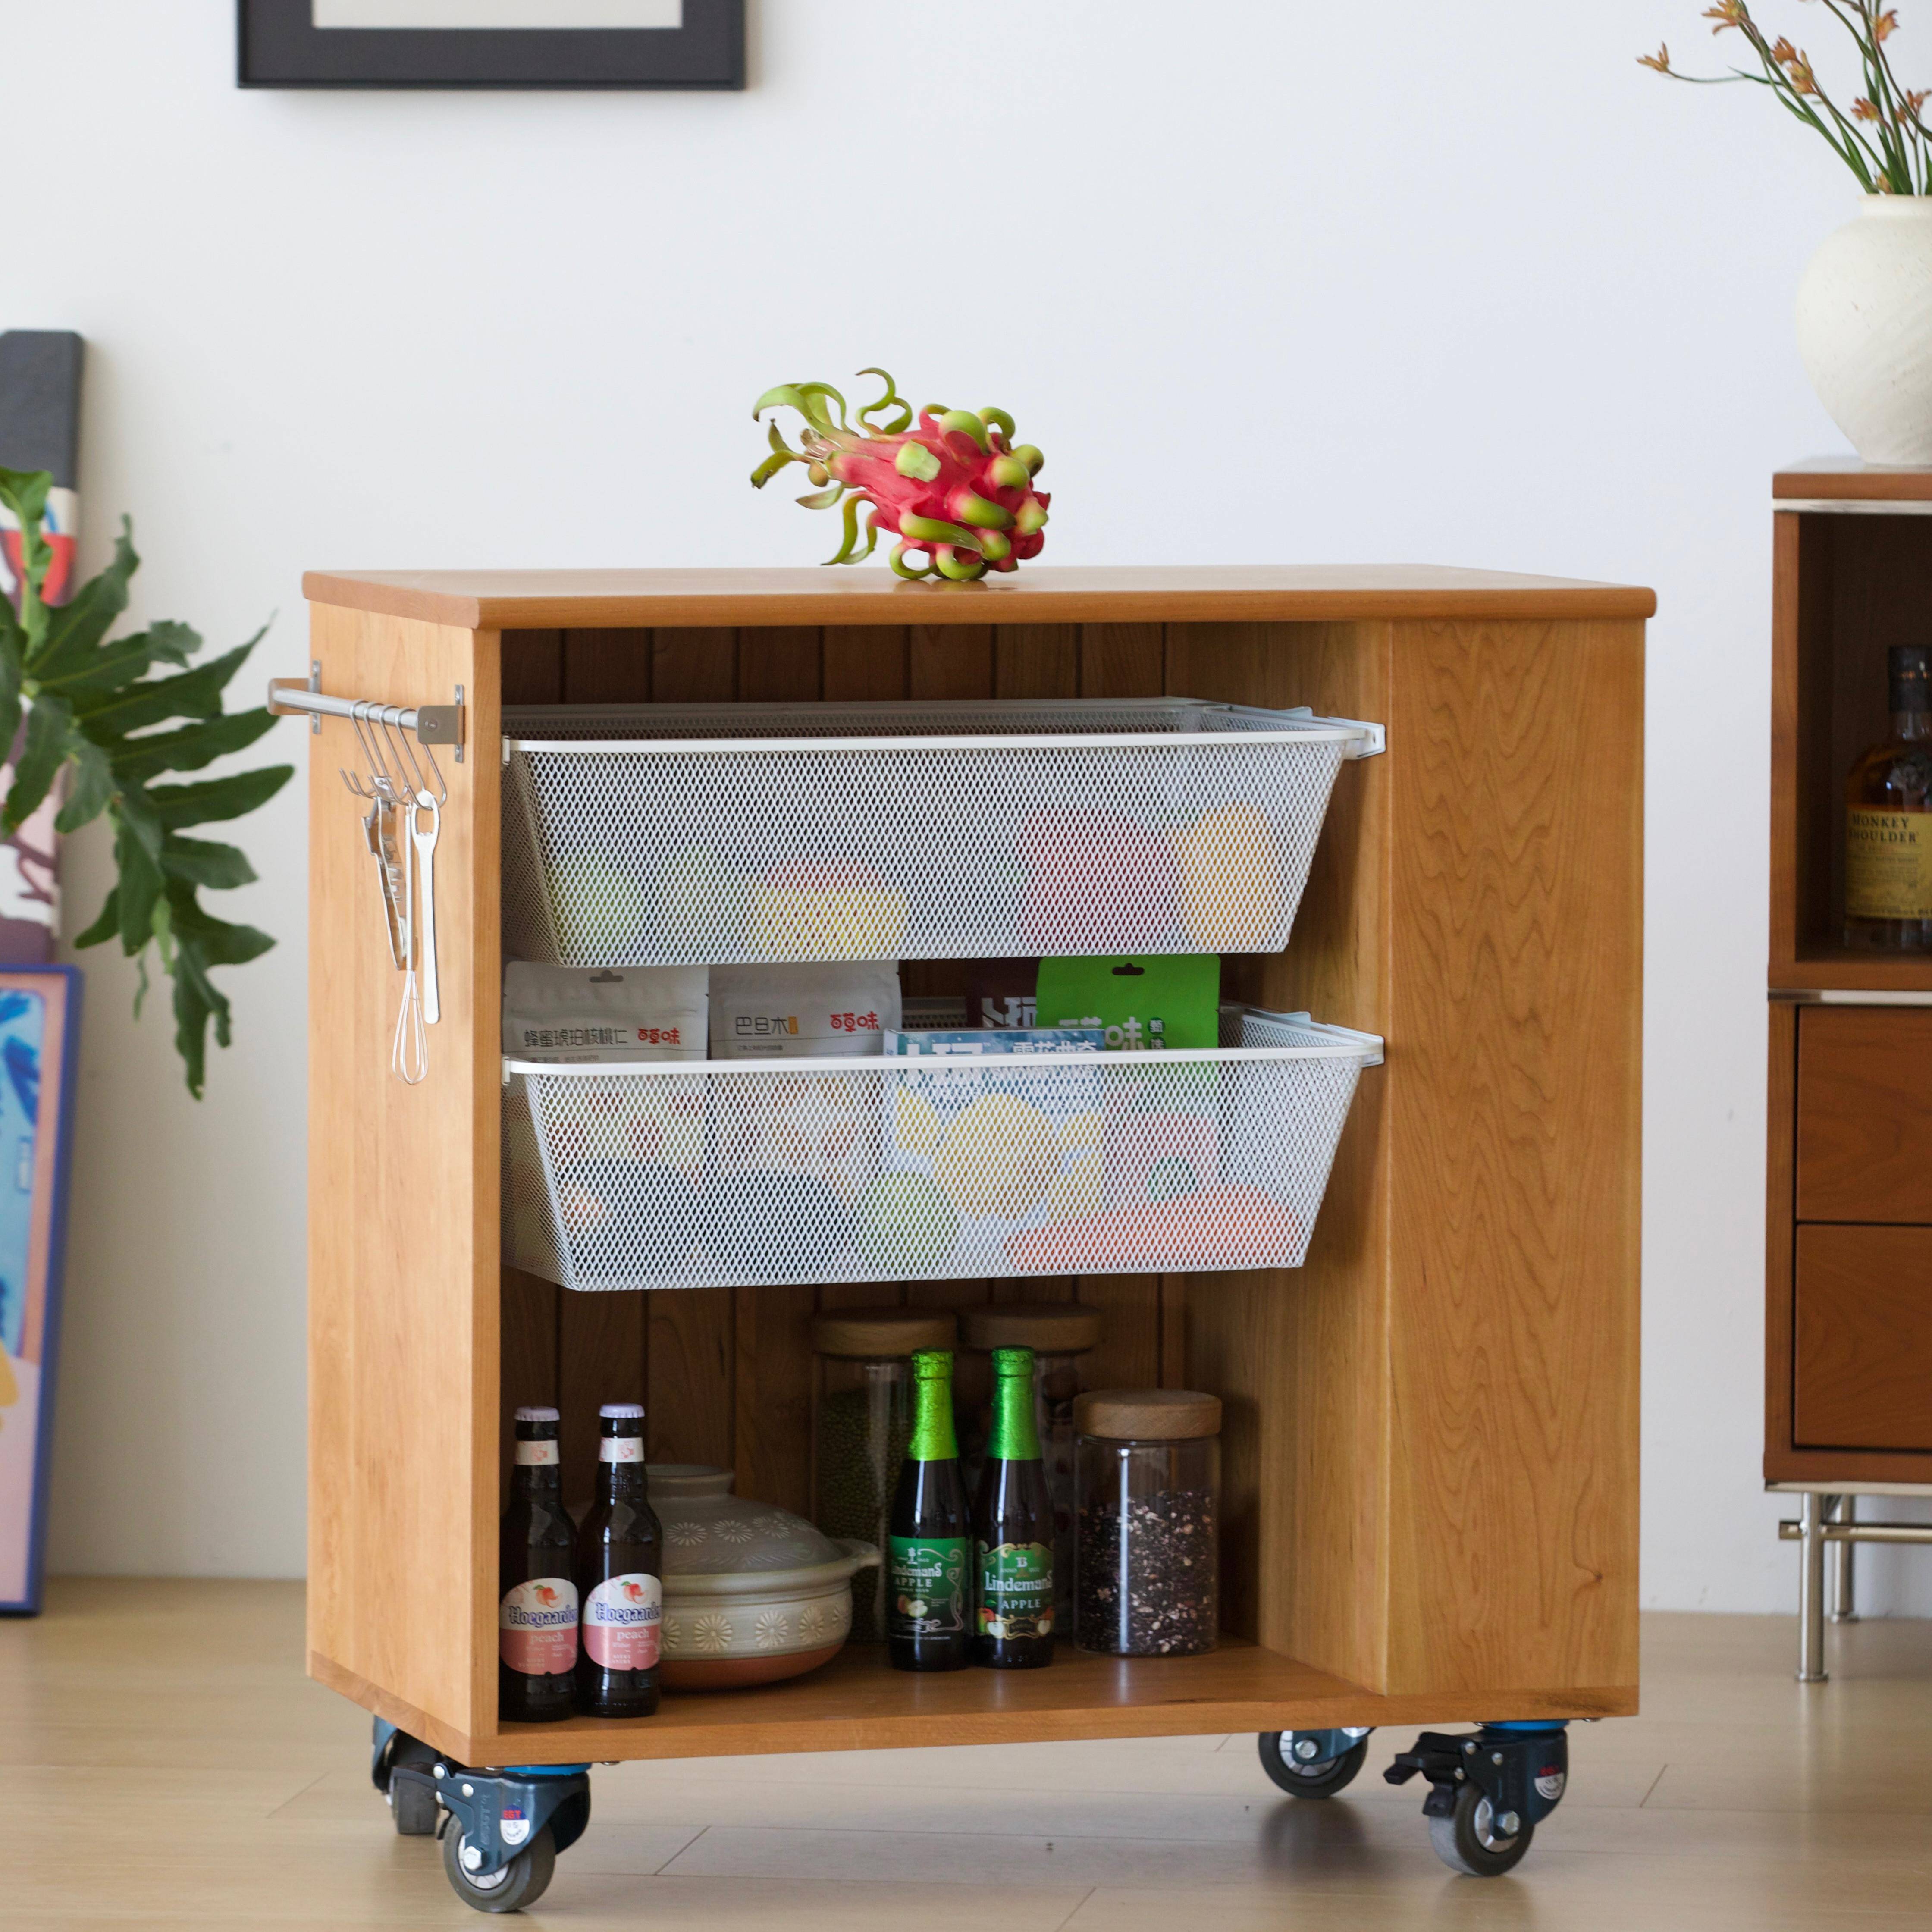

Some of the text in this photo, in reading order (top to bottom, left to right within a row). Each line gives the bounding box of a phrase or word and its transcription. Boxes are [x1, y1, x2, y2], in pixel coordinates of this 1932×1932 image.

[735, 1016, 789, 1035] 巴旦木
[830, 1011, 880, 1032] 百草味
[524, 1027, 627, 1047] 蜂蜜琥珀核桃仁
[637, 1027, 681, 1044] 百草味
[895, 1578, 933, 1587] APPLE
[1001, 1599, 1041, 1609] APPLE
[530, 1632, 564, 1644] peach
[617, 1628, 650, 1640] peach
